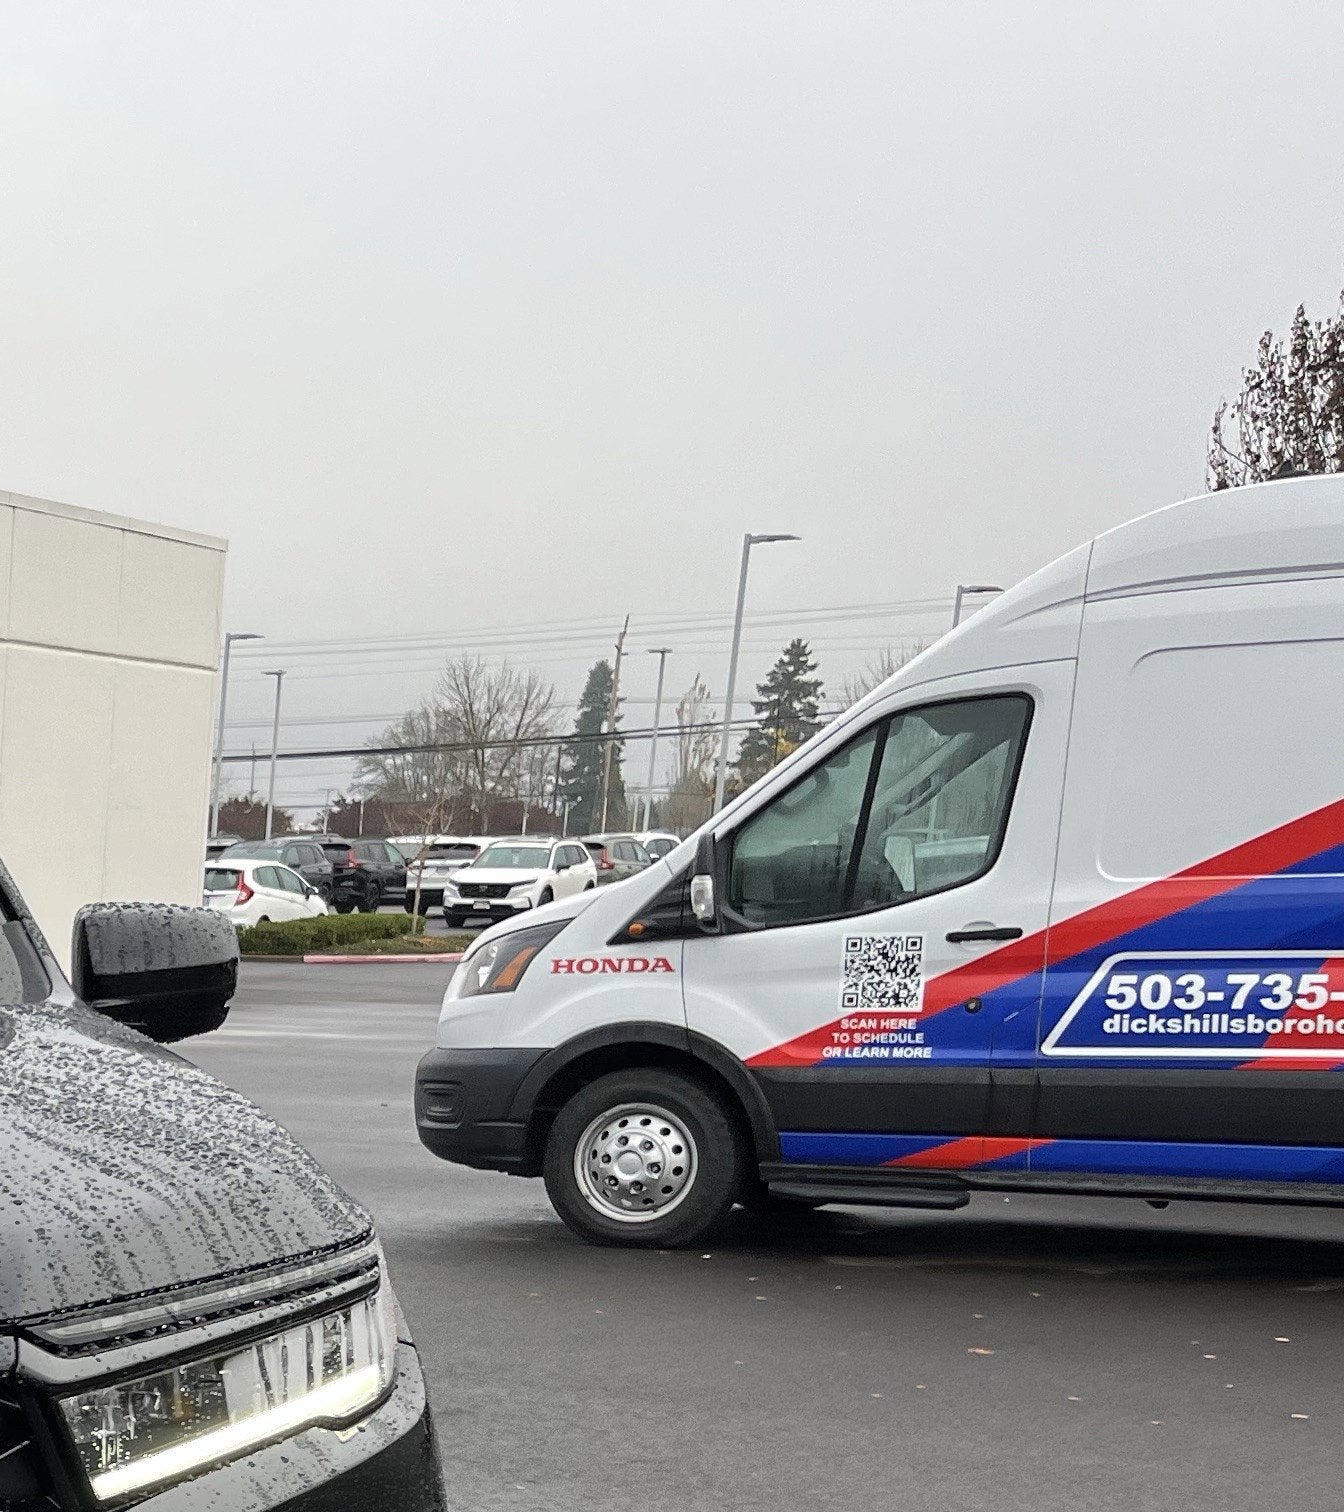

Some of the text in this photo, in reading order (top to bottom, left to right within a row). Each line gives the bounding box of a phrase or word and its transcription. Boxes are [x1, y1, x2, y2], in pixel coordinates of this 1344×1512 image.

[551, 957, 675, 974] HONDA
[840, 1018, 917, 1030] SCAN HERE
[832, 1032, 924, 1044] TO SCHEDULE
[822, 1046, 932, 1058] OR LEARN MORE
